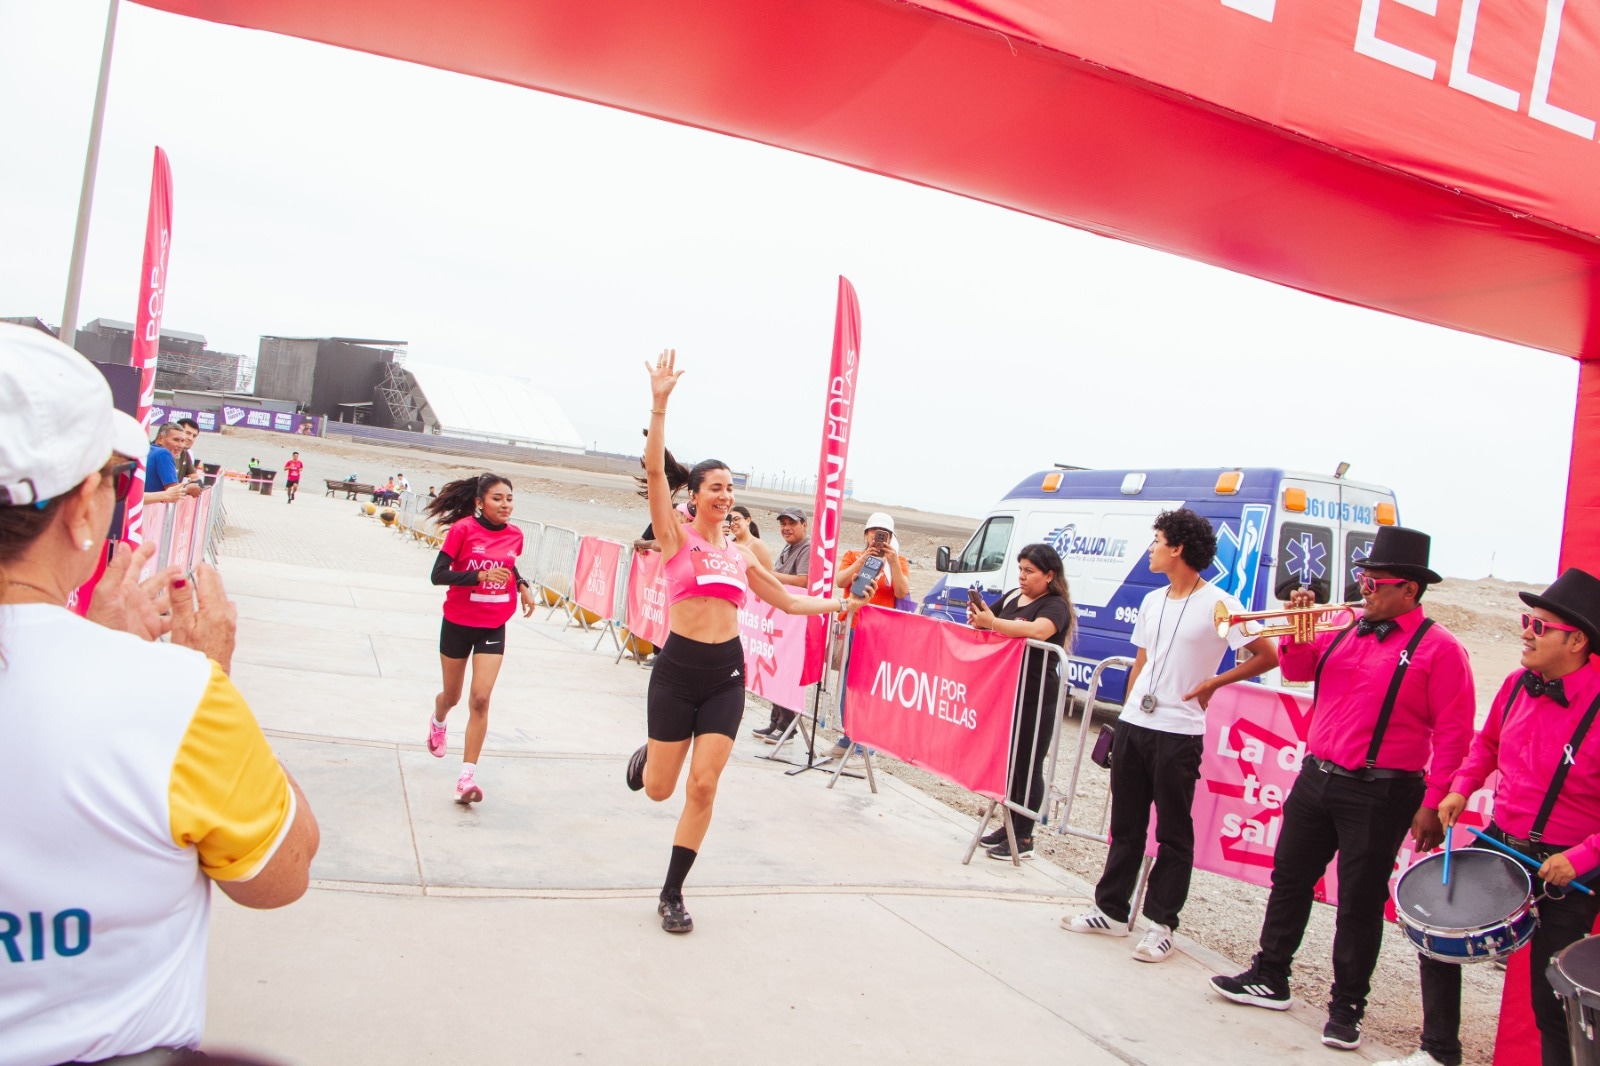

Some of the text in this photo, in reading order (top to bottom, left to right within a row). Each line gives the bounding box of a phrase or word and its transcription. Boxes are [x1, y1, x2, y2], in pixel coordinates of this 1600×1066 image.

[1354, 0, 1600, 142] ELL
[1328, 501, 1350, 522] 075
[1353, 505, 1371, 525] 143
[466, 560, 504, 571] AVON
[702, 559, 738, 574] 1025
[761, 617, 774, 635] en
[1124, 607, 1138, 624] 96
[750, 637, 774, 660] paso
[870, 660, 939, 716] AVON
[940, 677, 967, 704] POR
[938, 699, 977, 730] ELLAS
[1217, 725, 1265, 765] La
[1243, 773, 1292, 810] te
[1220, 813, 1280, 849] sal
[0, 908, 92, 964] RIO
